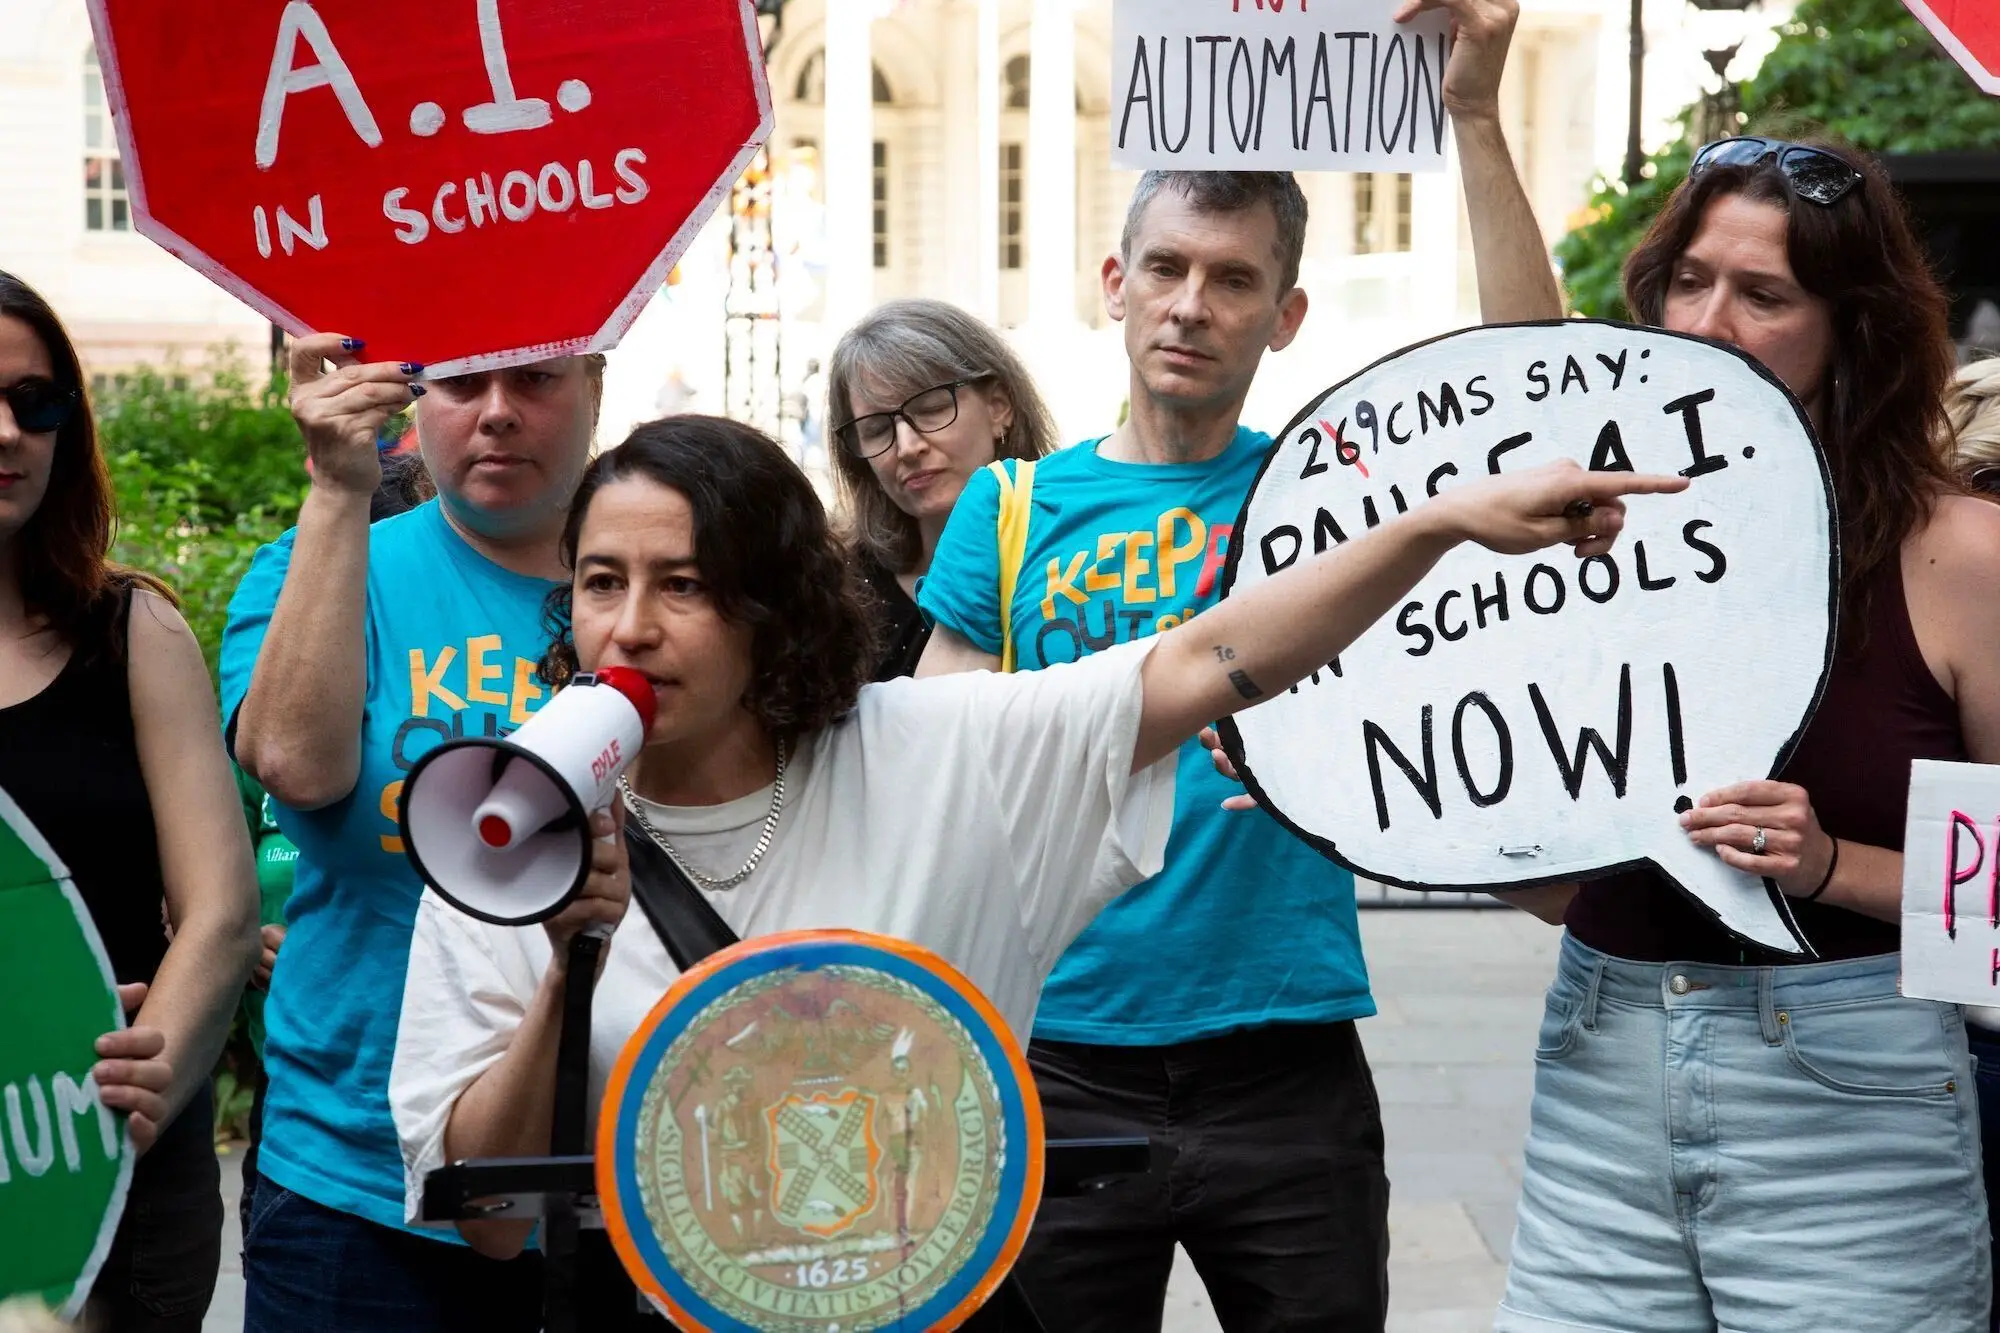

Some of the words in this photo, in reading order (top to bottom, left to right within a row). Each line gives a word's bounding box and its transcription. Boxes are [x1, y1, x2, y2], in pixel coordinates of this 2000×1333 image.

[255, 0, 592, 170] A.I.
[1118, 32, 1446, 155] AUTOMATION
[252, 194, 328, 258] IN
[383, 148, 650, 244] SCHOOLS
[1526, 348, 1650, 401] SAY:
[1040, 507, 1207, 620] KEEP
[1396, 519, 1727, 656] SCHOOLS
[409, 634, 560, 723] KEE
[1036, 600, 1152, 669] OUT
[1363, 662, 1694, 832] NOW!
[797, 1258, 868, 1287] 1625
